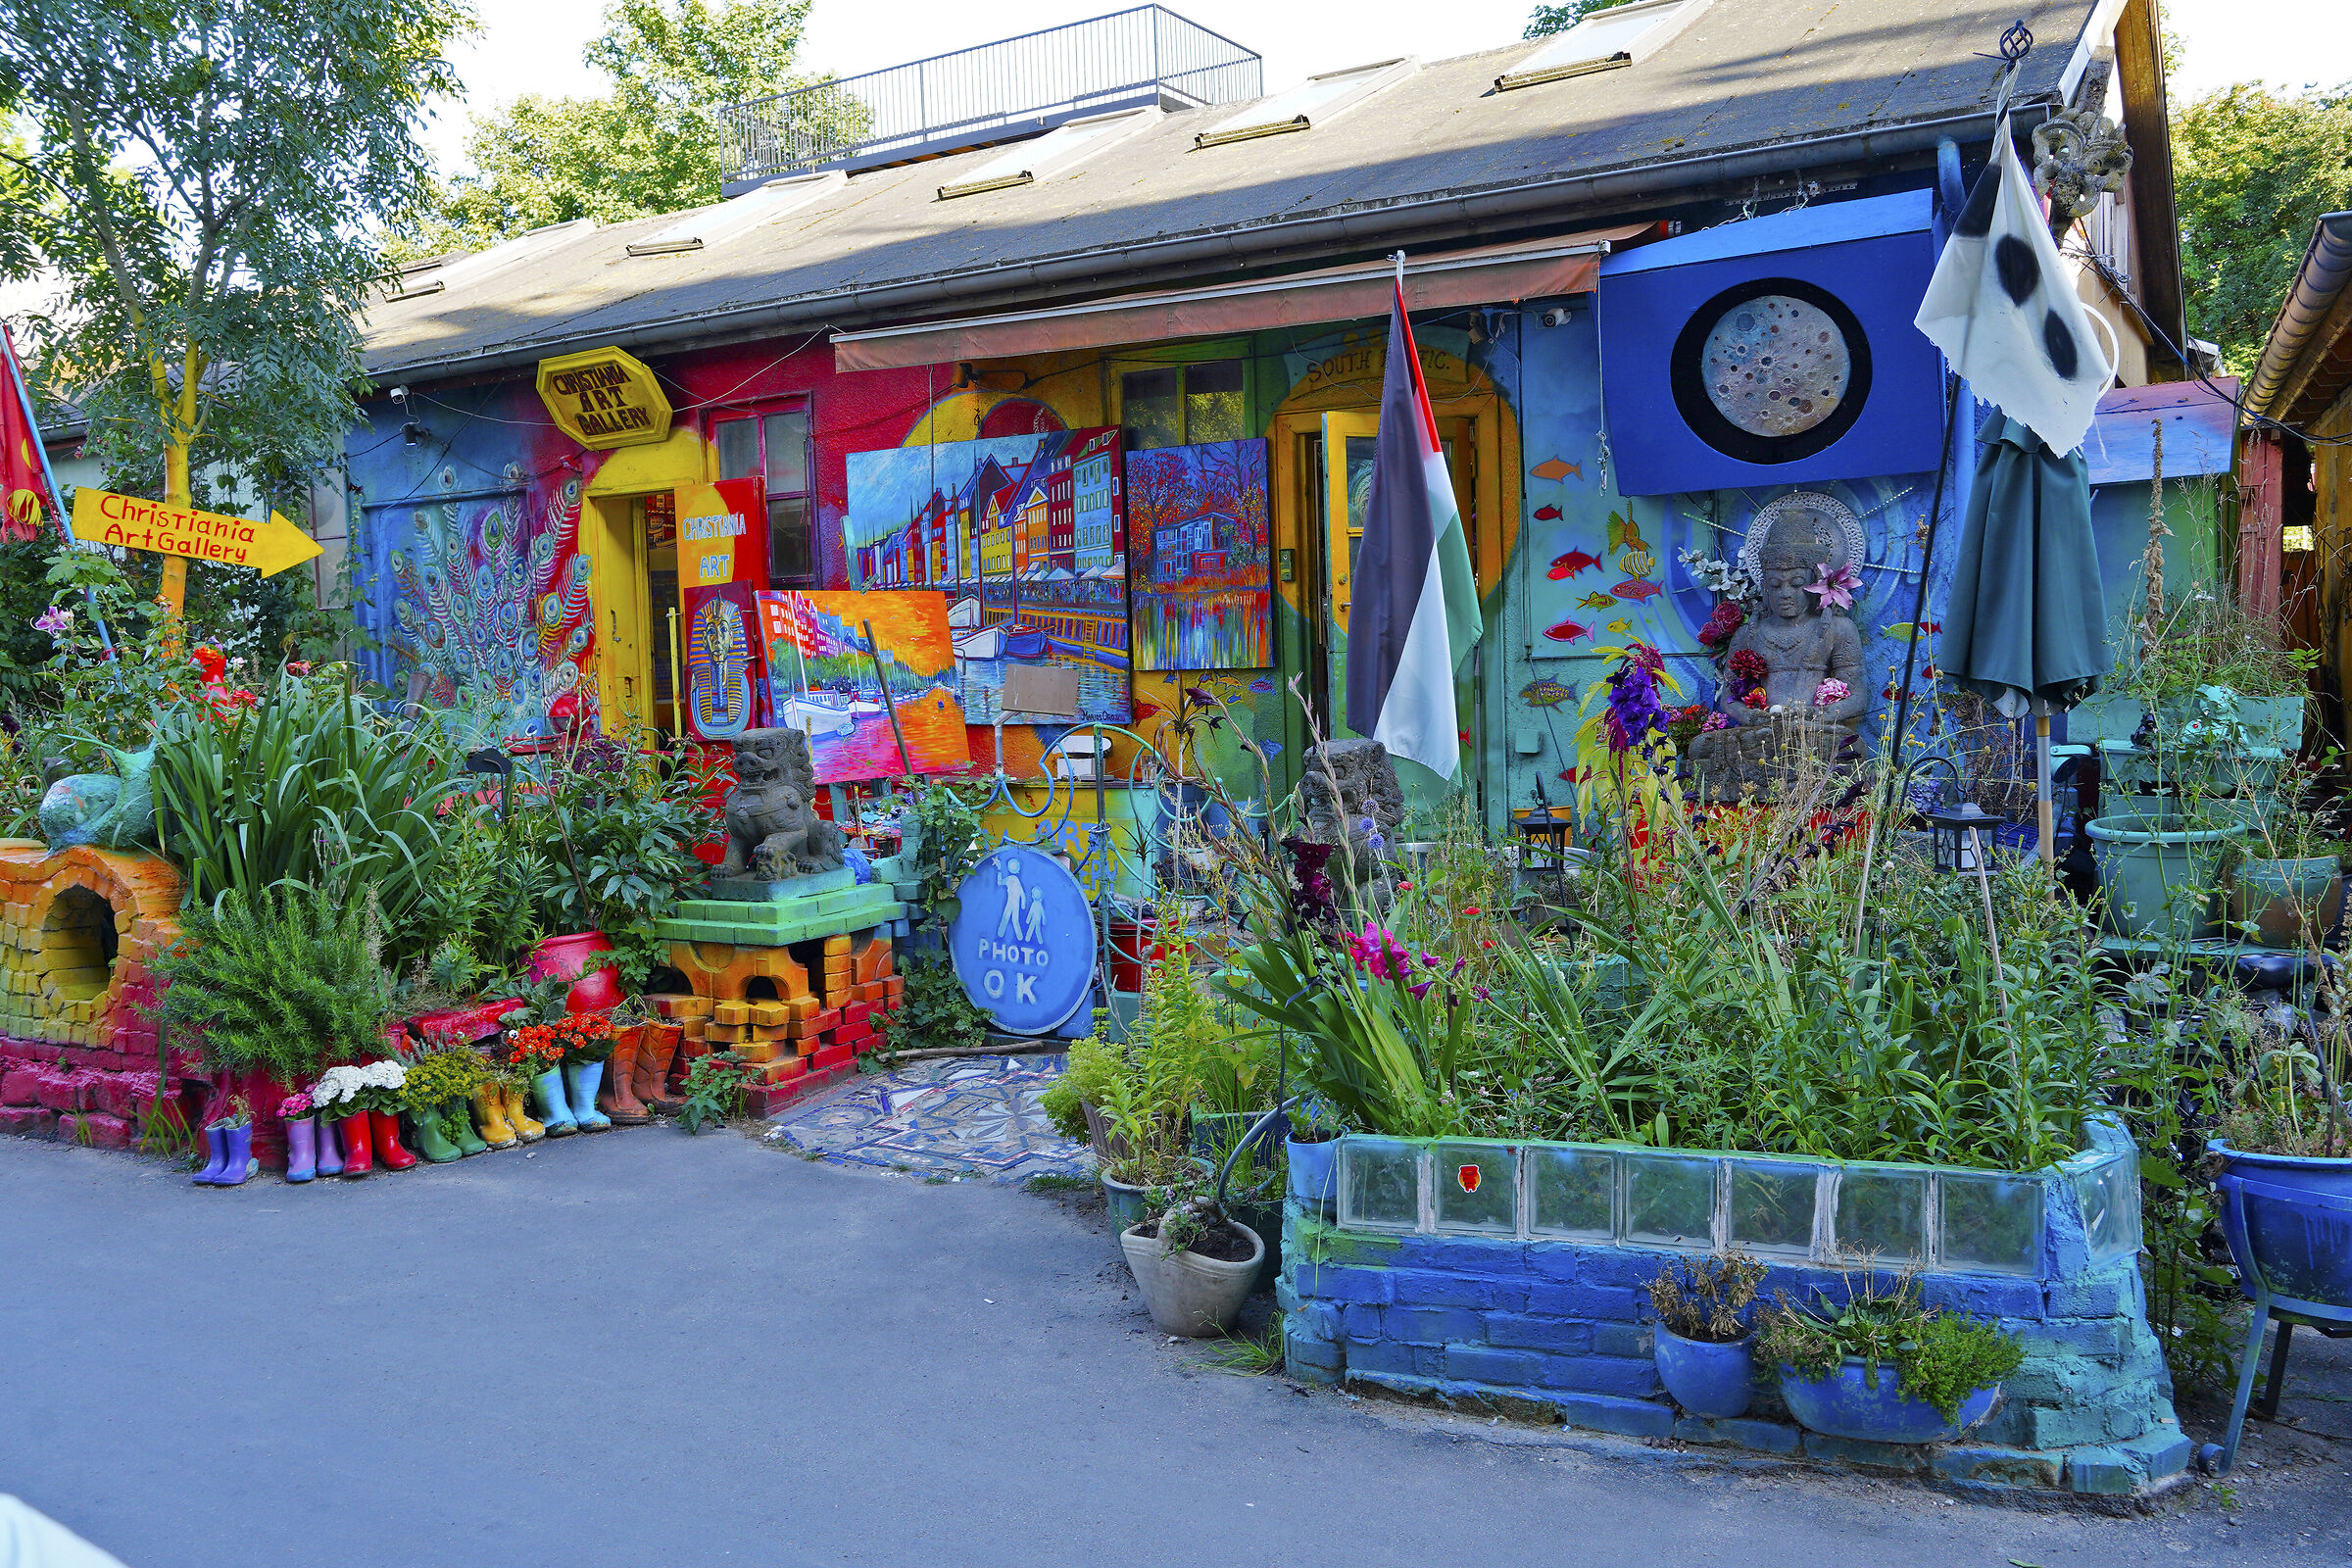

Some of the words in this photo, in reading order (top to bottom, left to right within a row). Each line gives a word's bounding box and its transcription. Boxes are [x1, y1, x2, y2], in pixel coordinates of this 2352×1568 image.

[552, 365, 632, 396] CHRISTIANIA
[1306, 350, 1372, 383] SOUTH
[579, 386, 627, 413] ART
[575, 408, 651, 436] GALLERY
[105, 523, 153, 548] Art
[157, 532, 247, 563] Gallery
[700, 554, 729, 578] ART
[978, 938, 1049, 967] PHOTO
